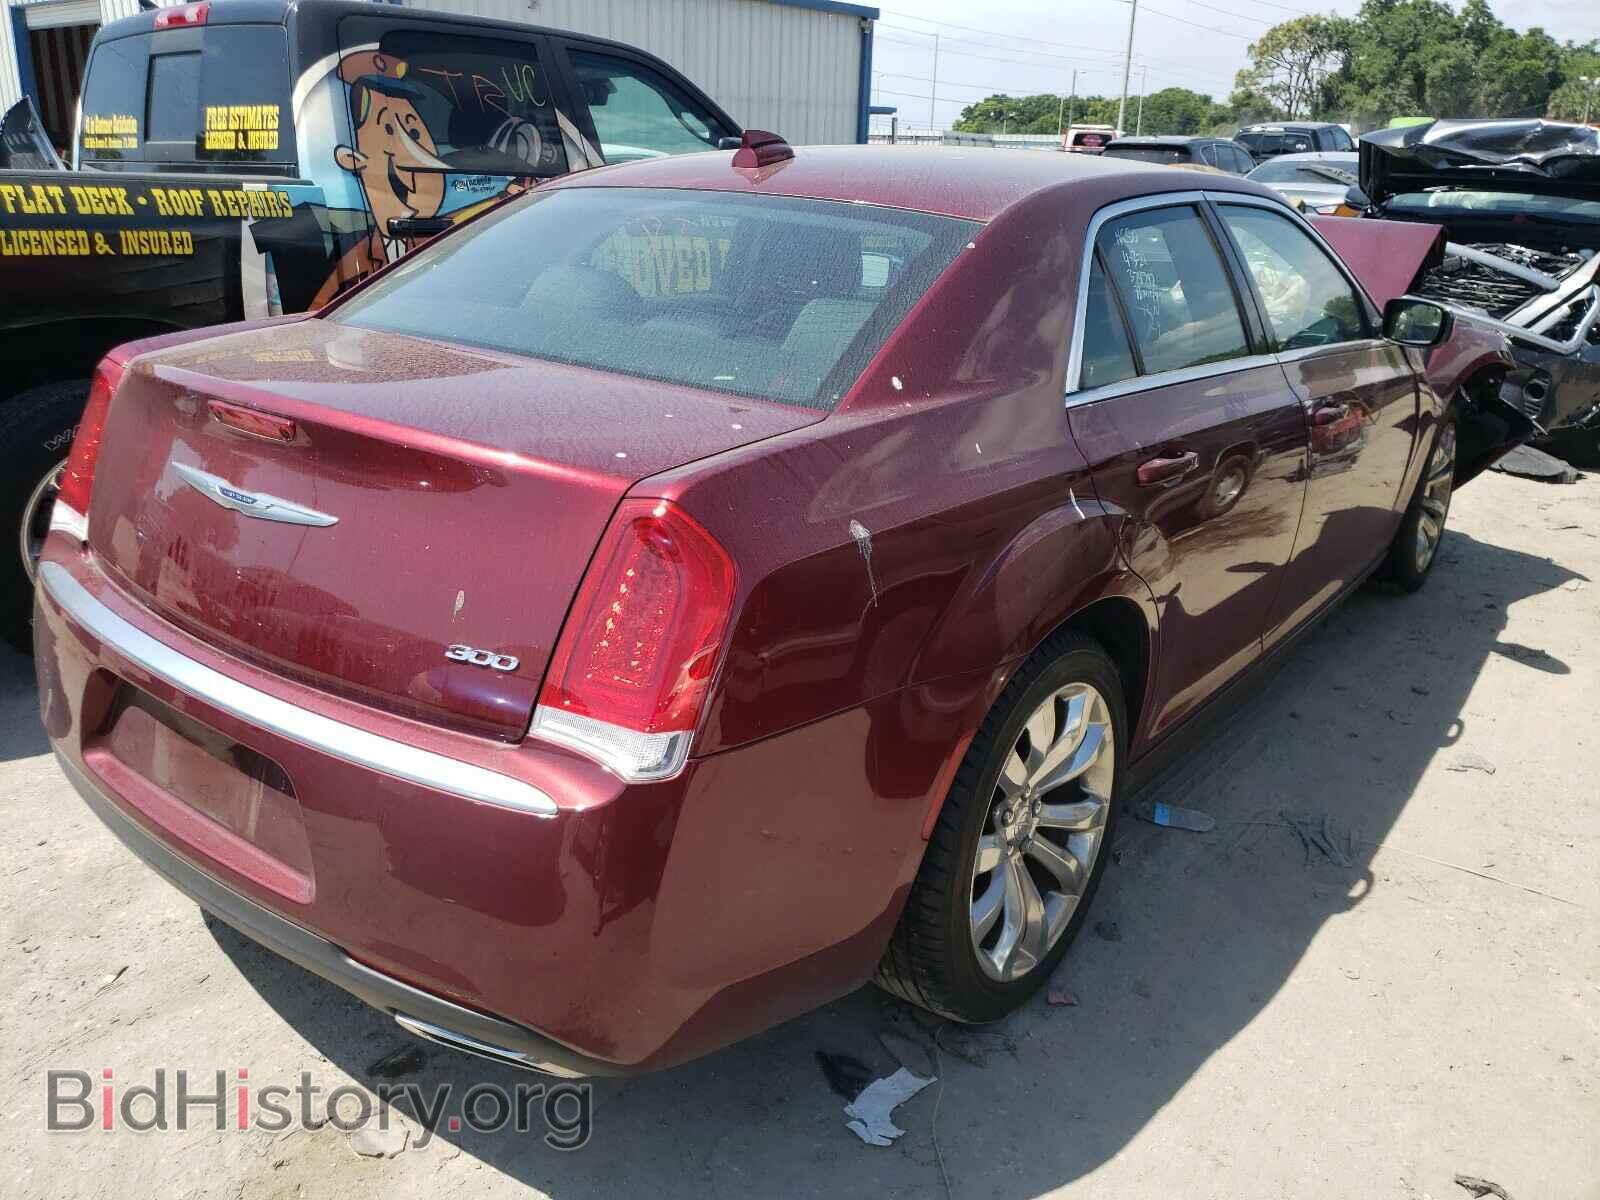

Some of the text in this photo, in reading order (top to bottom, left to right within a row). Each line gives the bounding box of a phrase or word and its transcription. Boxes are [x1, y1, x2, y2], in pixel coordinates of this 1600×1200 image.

[206, 104, 280, 130] FREE ESTIMATES
[238, 131, 247, 150] &
[0, 184, 294, 218] FLAT DECK ROOF REPAIRS
[0, 230, 194, 256] LICENSED & INSURED
[445, 644, 519, 671] 300
